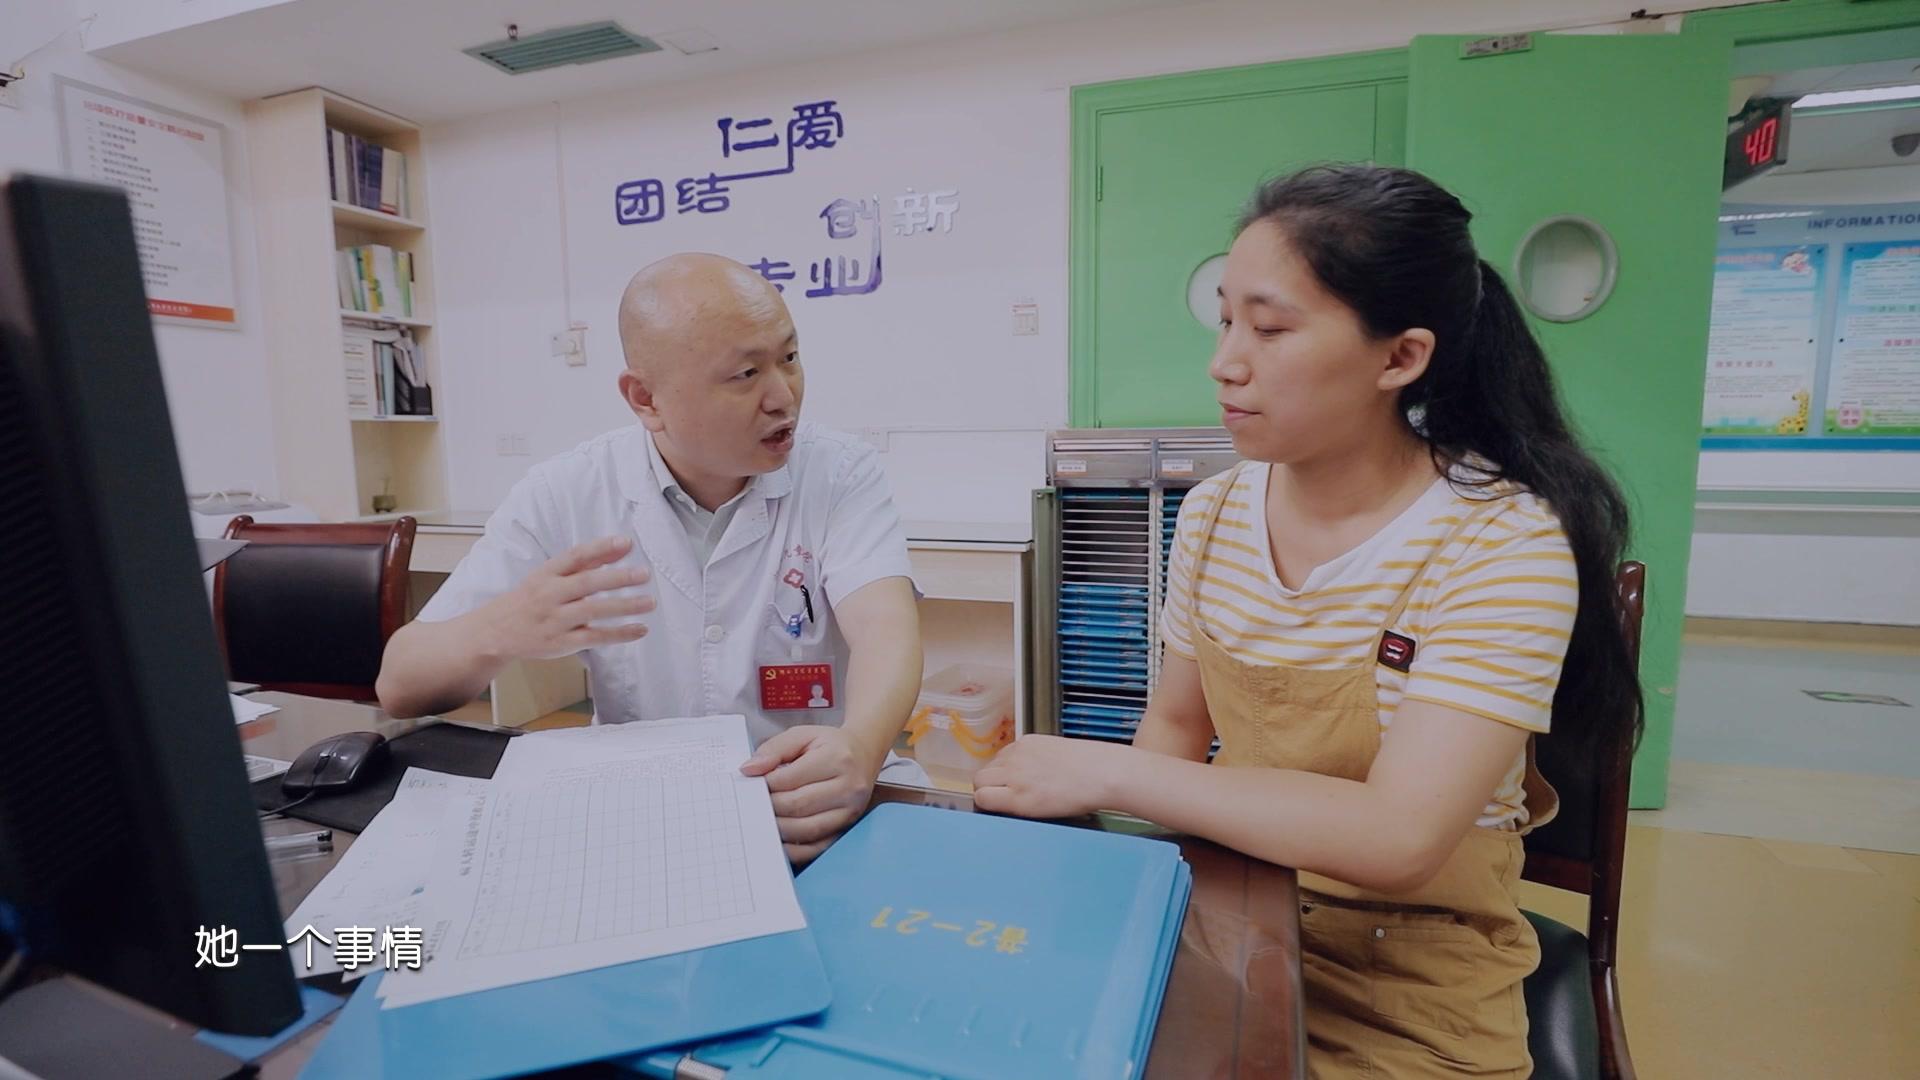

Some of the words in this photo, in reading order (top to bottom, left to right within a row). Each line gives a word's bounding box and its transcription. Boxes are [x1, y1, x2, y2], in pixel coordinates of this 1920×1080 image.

[718, 100, 843, 157] 仁爱
[1746, 118, 1777, 165] 40
[615, 173, 730, 225] 团结
[820, 187, 960, 240] 创新
[1807, 213, 1920, 231] INFORMATIO
